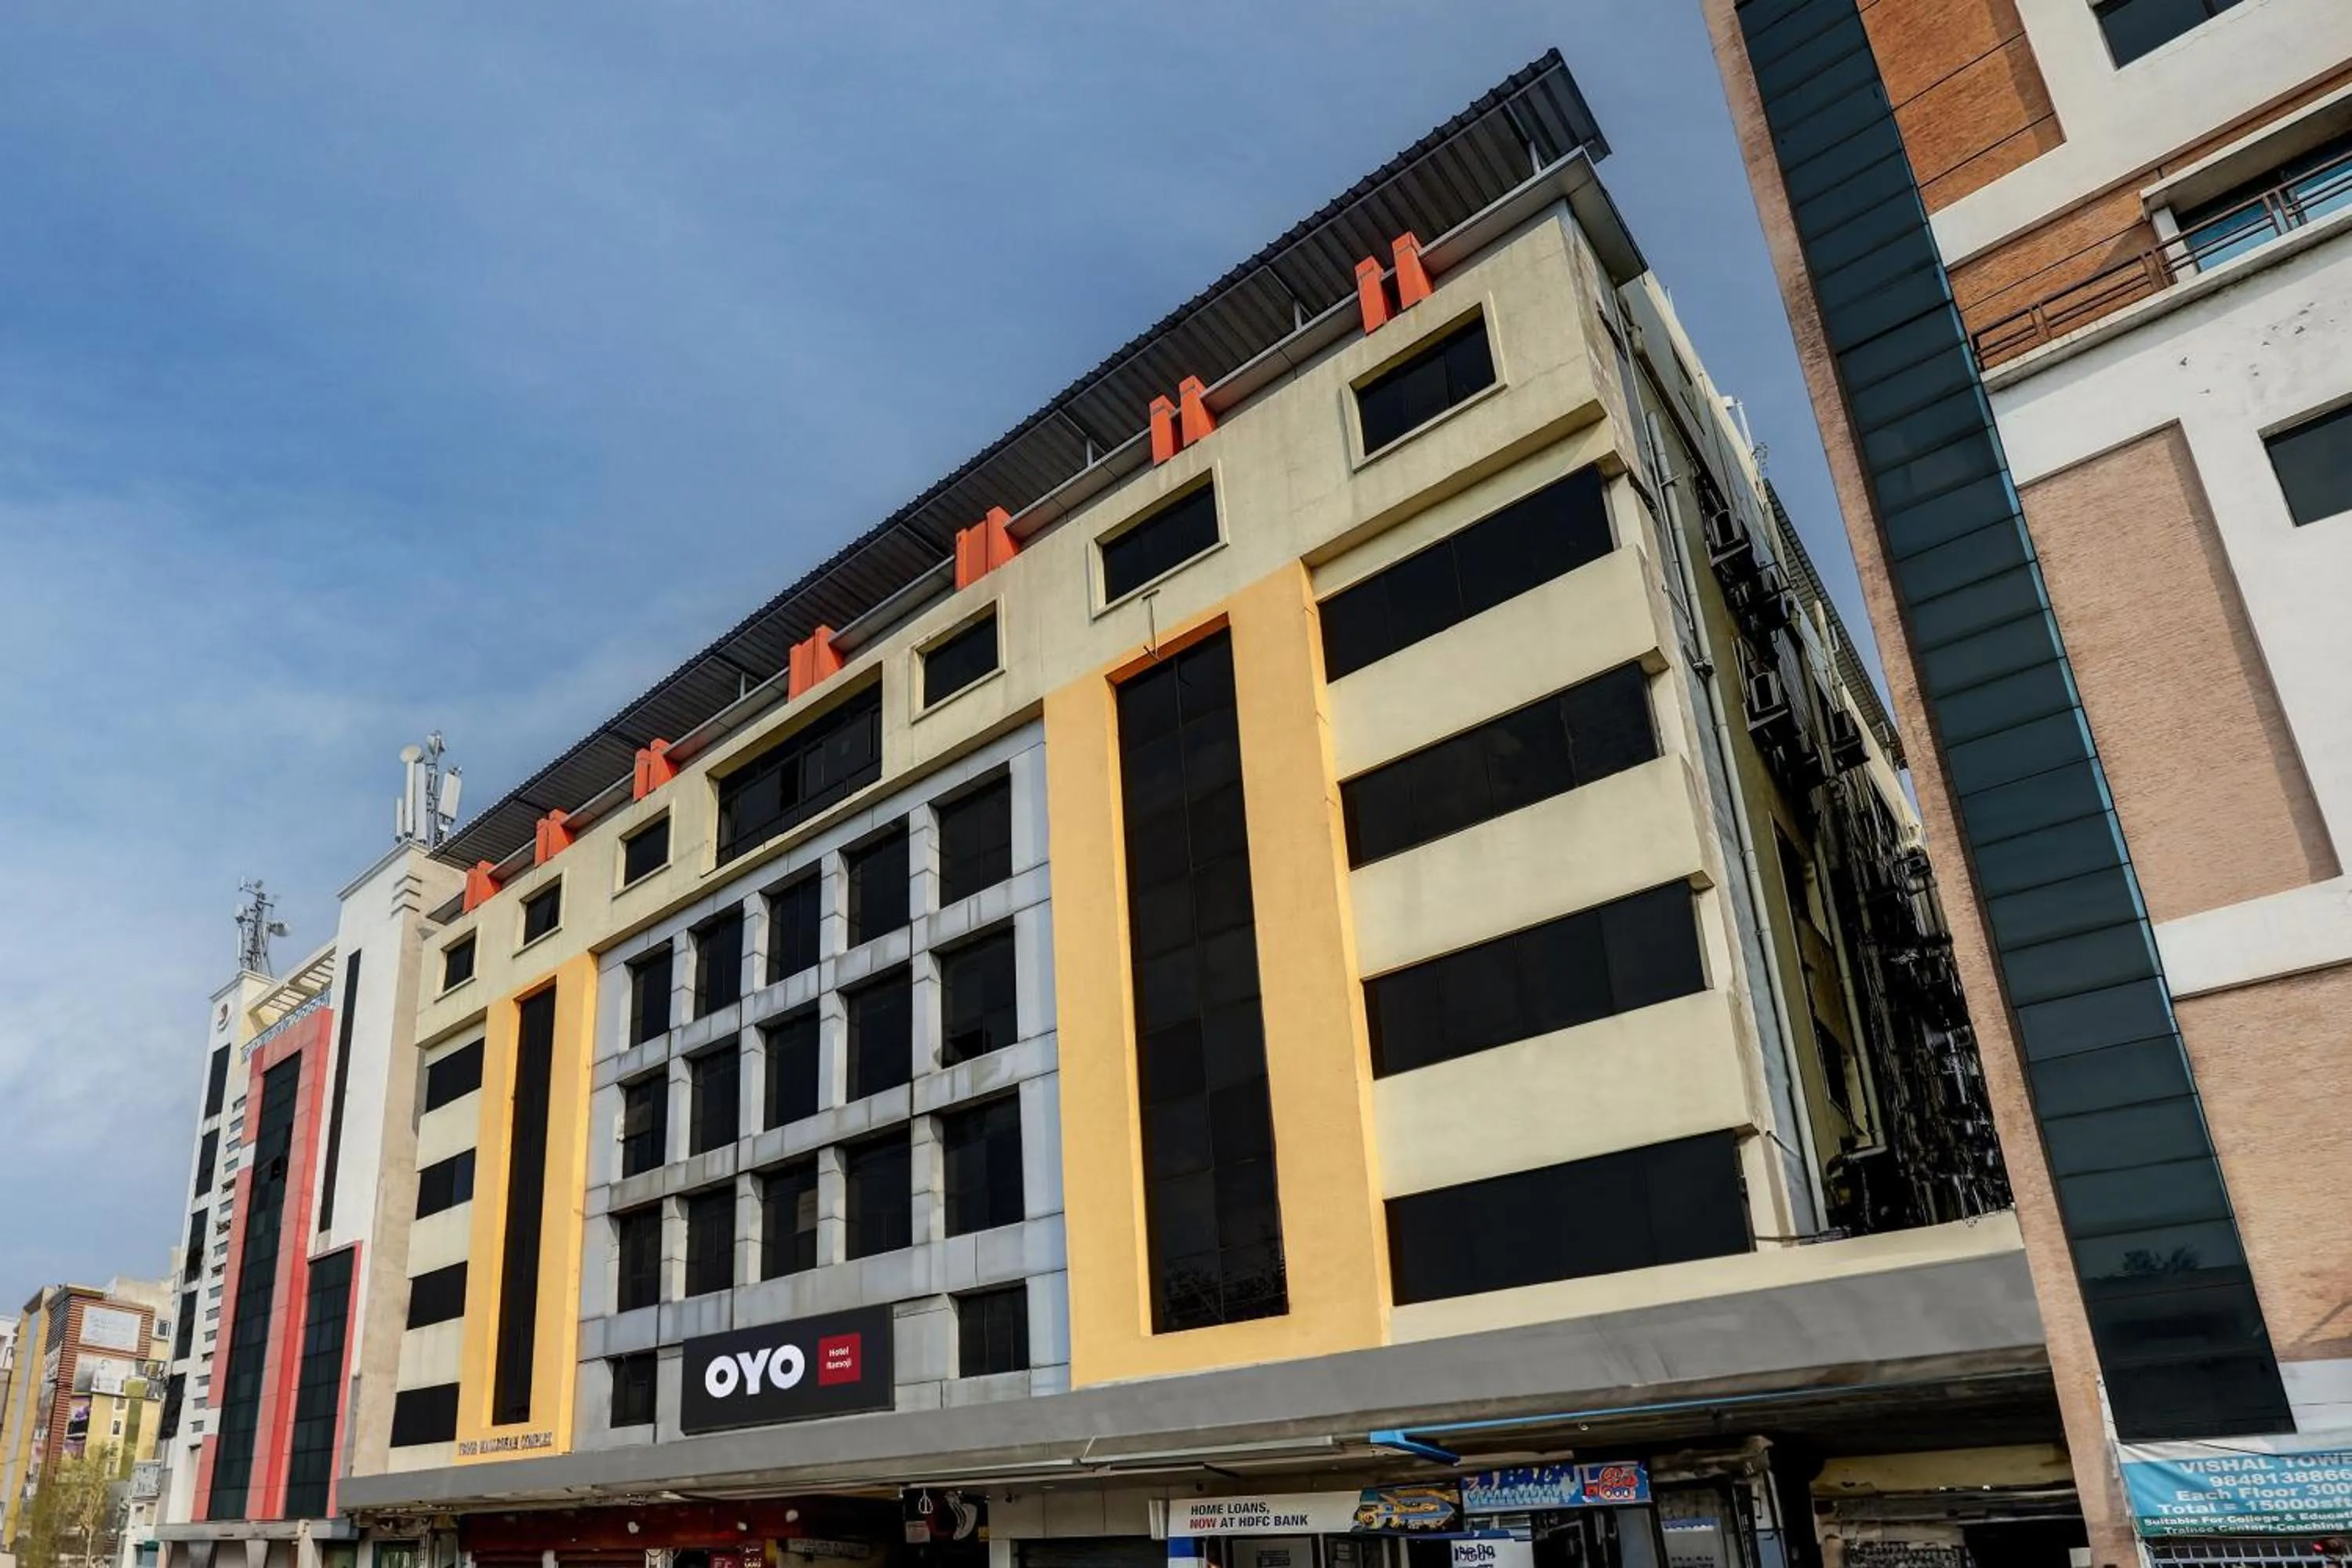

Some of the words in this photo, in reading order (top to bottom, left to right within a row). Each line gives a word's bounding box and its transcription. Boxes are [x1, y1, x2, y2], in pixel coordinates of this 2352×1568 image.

[705, 1344, 805, 1398] OYO
[2178, 1457, 2274, 1473] VISHAL
[2175, 1489, 2232, 1501] Each
[2238, 1486, 2299, 1499] Floor
[2306, 1482, 2352, 1497] 300
[1191, 1504, 1224, 1515] HOME
[1227, 1501, 1270, 1515] LOANS,
[2157, 1502, 2217, 1515] Total
[1189, 1518, 1217, 1529] NOW
[1219, 1517, 1236, 1528] AT
[1238, 1515, 1271, 1527] HDFC
[1274, 1514, 1308, 1526] BANK
[2144, 1516, 2198, 1526] Suitable
[2201, 1515, 2224, 1524] For
[2227, 1513, 2281, 1524] College
